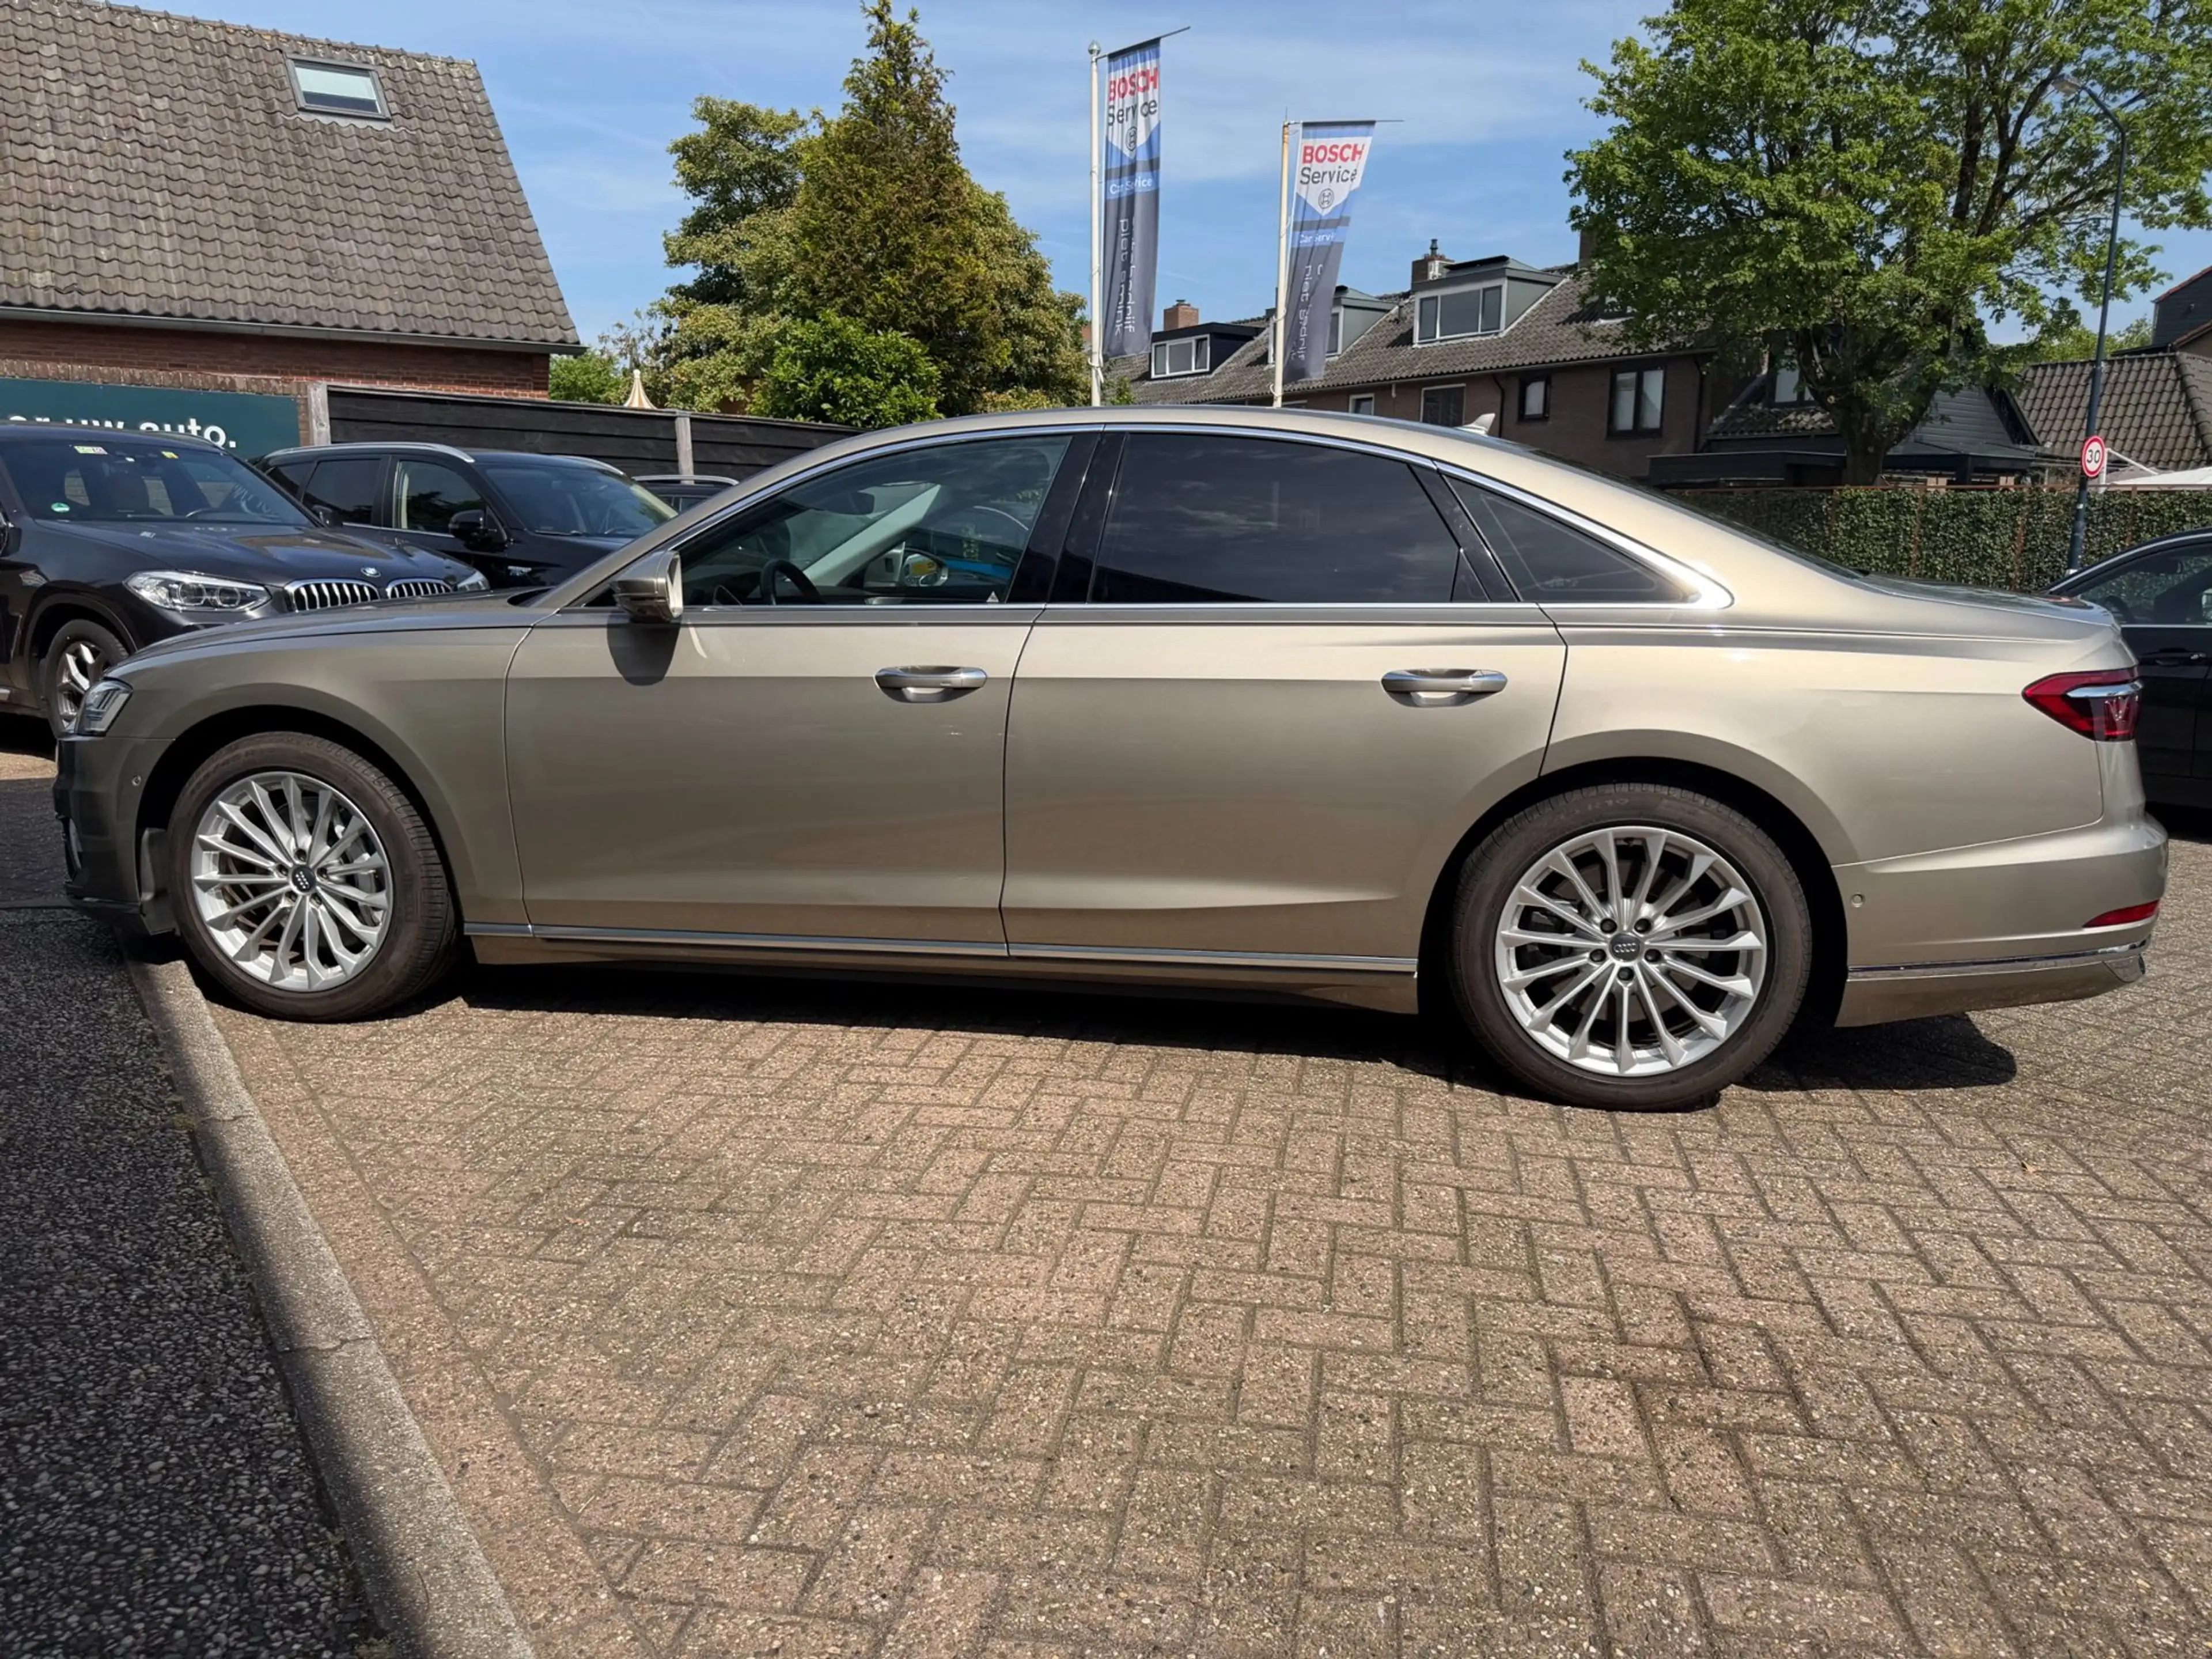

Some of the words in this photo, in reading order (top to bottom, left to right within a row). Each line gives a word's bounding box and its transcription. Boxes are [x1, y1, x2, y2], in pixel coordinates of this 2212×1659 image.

[1109, 67, 1159, 102] BOSCH
[1108, 100, 1157, 126] Servce
[1302, 143, 1365, 164] BOSCH
[2086, 449, 2101, 464] 30
